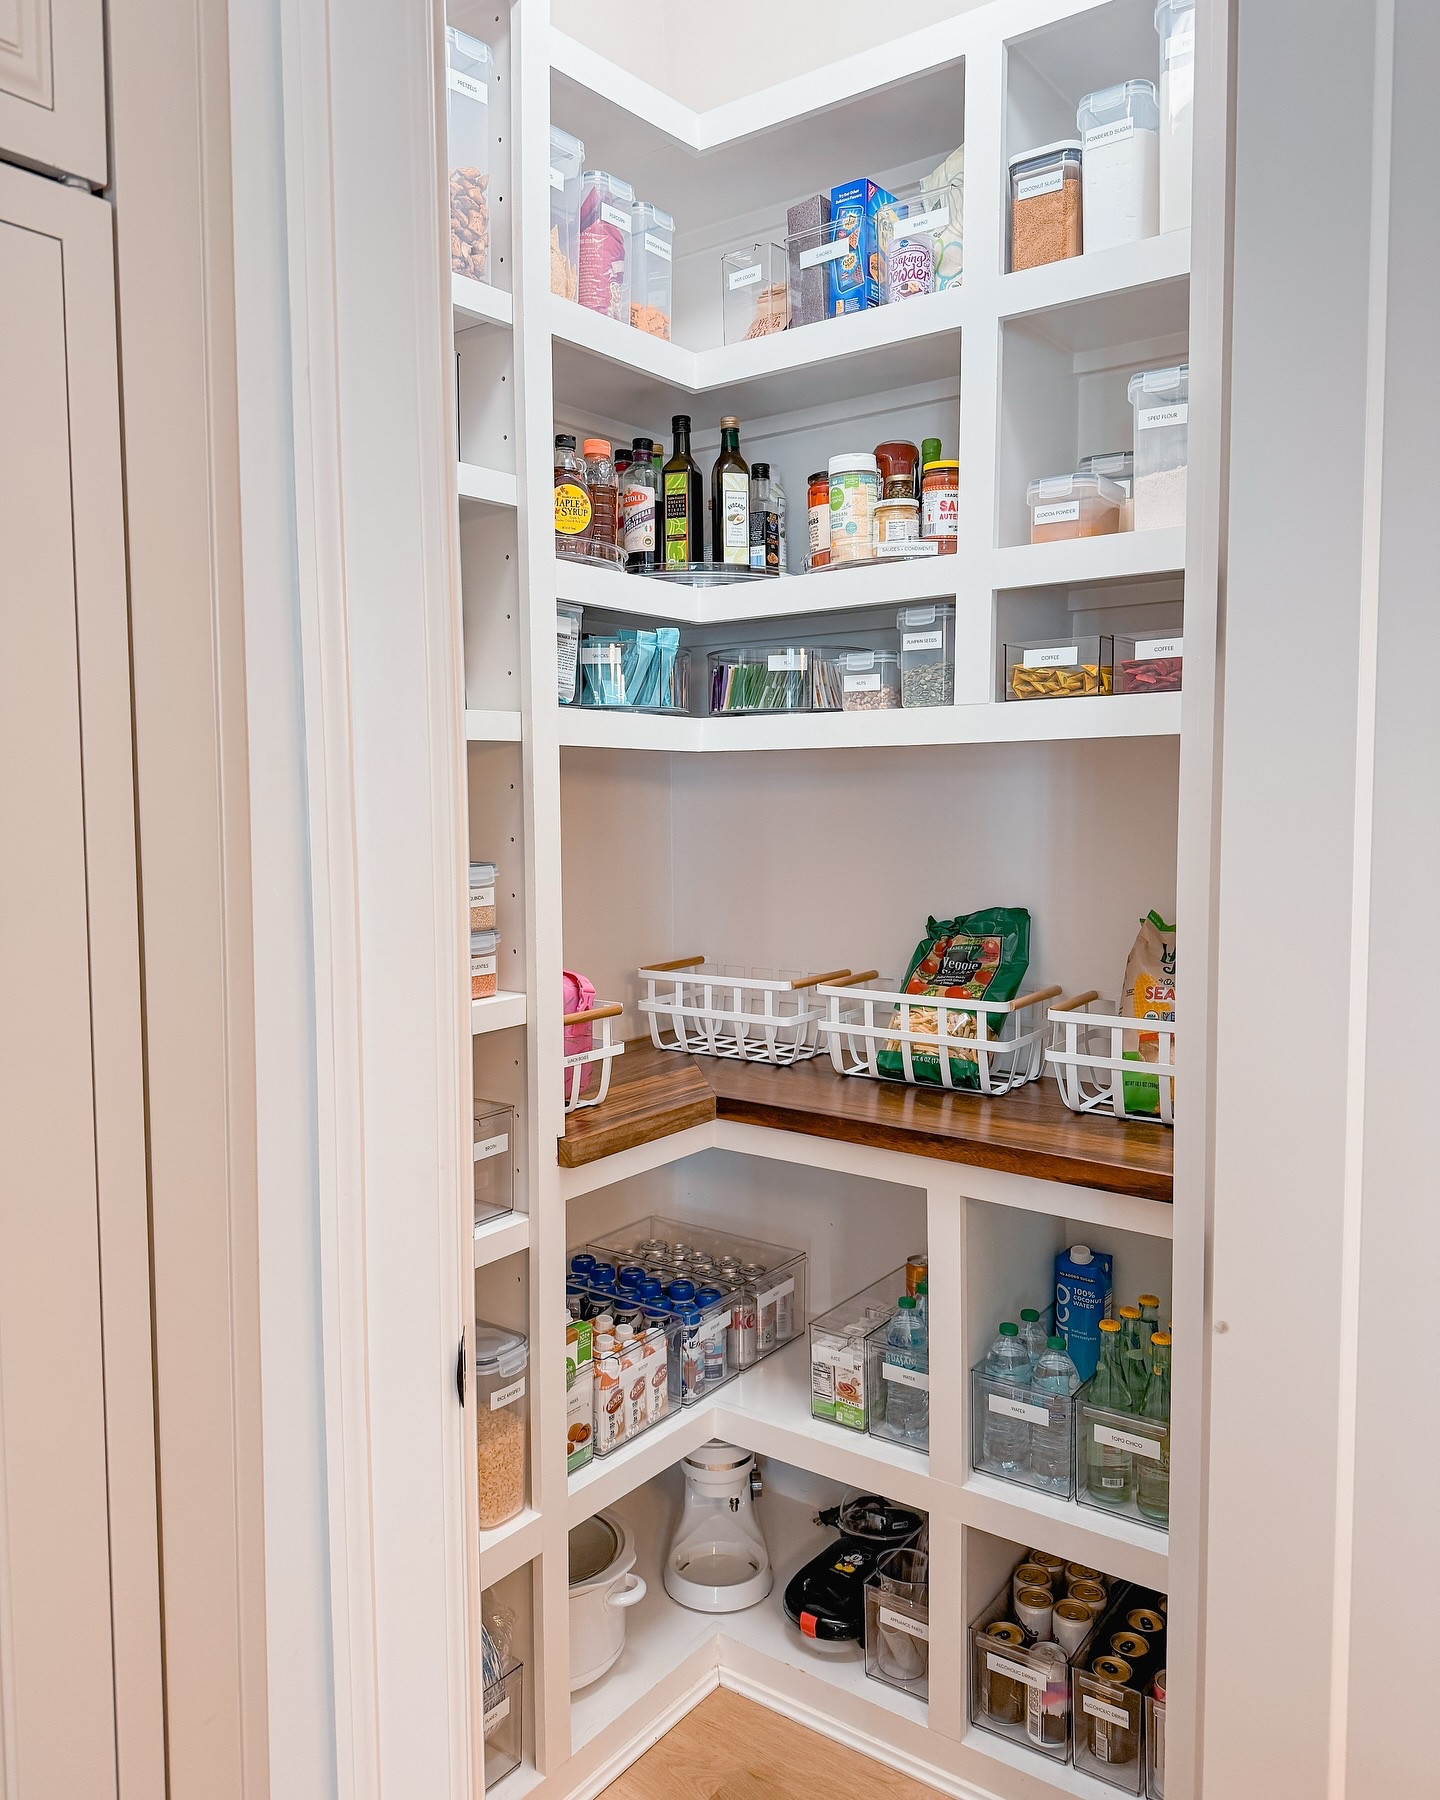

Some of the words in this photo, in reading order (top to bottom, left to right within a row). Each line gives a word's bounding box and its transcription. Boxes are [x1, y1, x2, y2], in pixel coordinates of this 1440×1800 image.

[457, 79, 478, 93] PRETZELS
[1086, 130, 1113, 143] POWDERED
[1113, 125, 1132, 136] SUGAR
[1020, 183, 1044, 194] COCONUT
[1044, 178, 1062, 188] SUGAR
[913, 219, 928, 229] BAKING
[891, 253, 926, 271] Baking
[1160, 412, 1178, 420] FLOUR
[561, 507, 588, 516] SYRUP
[1036, 511, 1055, 519] COCOA
[1055, 508, 1075, 516] POWDER
[943, 957, 978, 970] Veggie
[1073, 1287, 1096, 1299] 100%
[1073, 1295, 1103, 1304] COCONUT
[1073, 1301, 1095, 1310] WATER
[902, 1374, 915, 1382] WATER
[1011, 1406, 1026, 1415] WATER
[1111, 1435, 1125, 1445] TOPO
[1125, 1439, 1143, 1449] CHICO
[890, 1616, 910, 1629] APPLIANCE
[995, 1662, 1021, 1676] ALCOHOLIC
[1021, 1672, 1038, 1683] DRINKS
[1084, 1701, 1112, 1717] ALCOHOLIC
[1111, 1712, 1128, 1723] DRINKS
